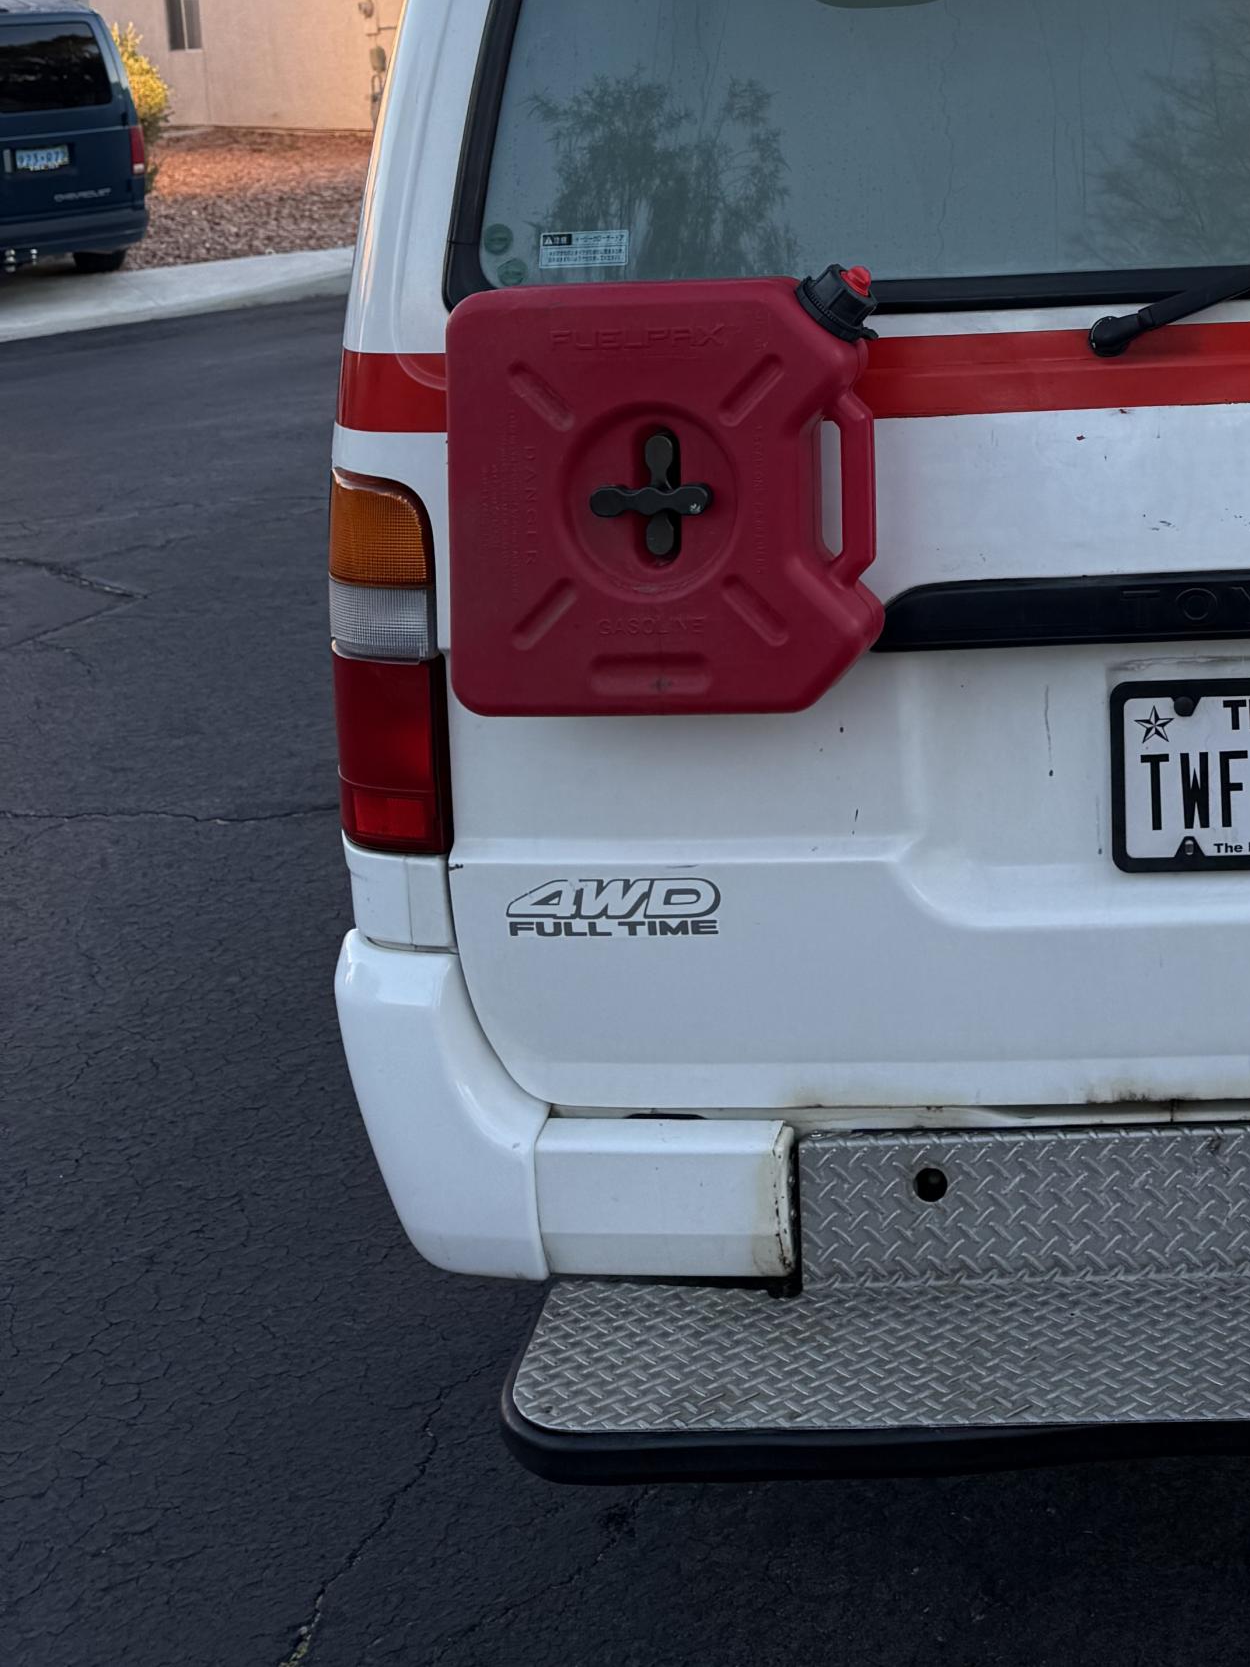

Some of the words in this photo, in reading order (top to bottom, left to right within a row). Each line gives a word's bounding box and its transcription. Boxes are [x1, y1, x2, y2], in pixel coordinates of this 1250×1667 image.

[1140, 750, 1248, 831] TWF
[1213, 842, 1243, 854] The
[506, 877, 721, 919] 4WD
[509, 921, 613, 937] FULL
[617, 919, 719, 936] TIME
